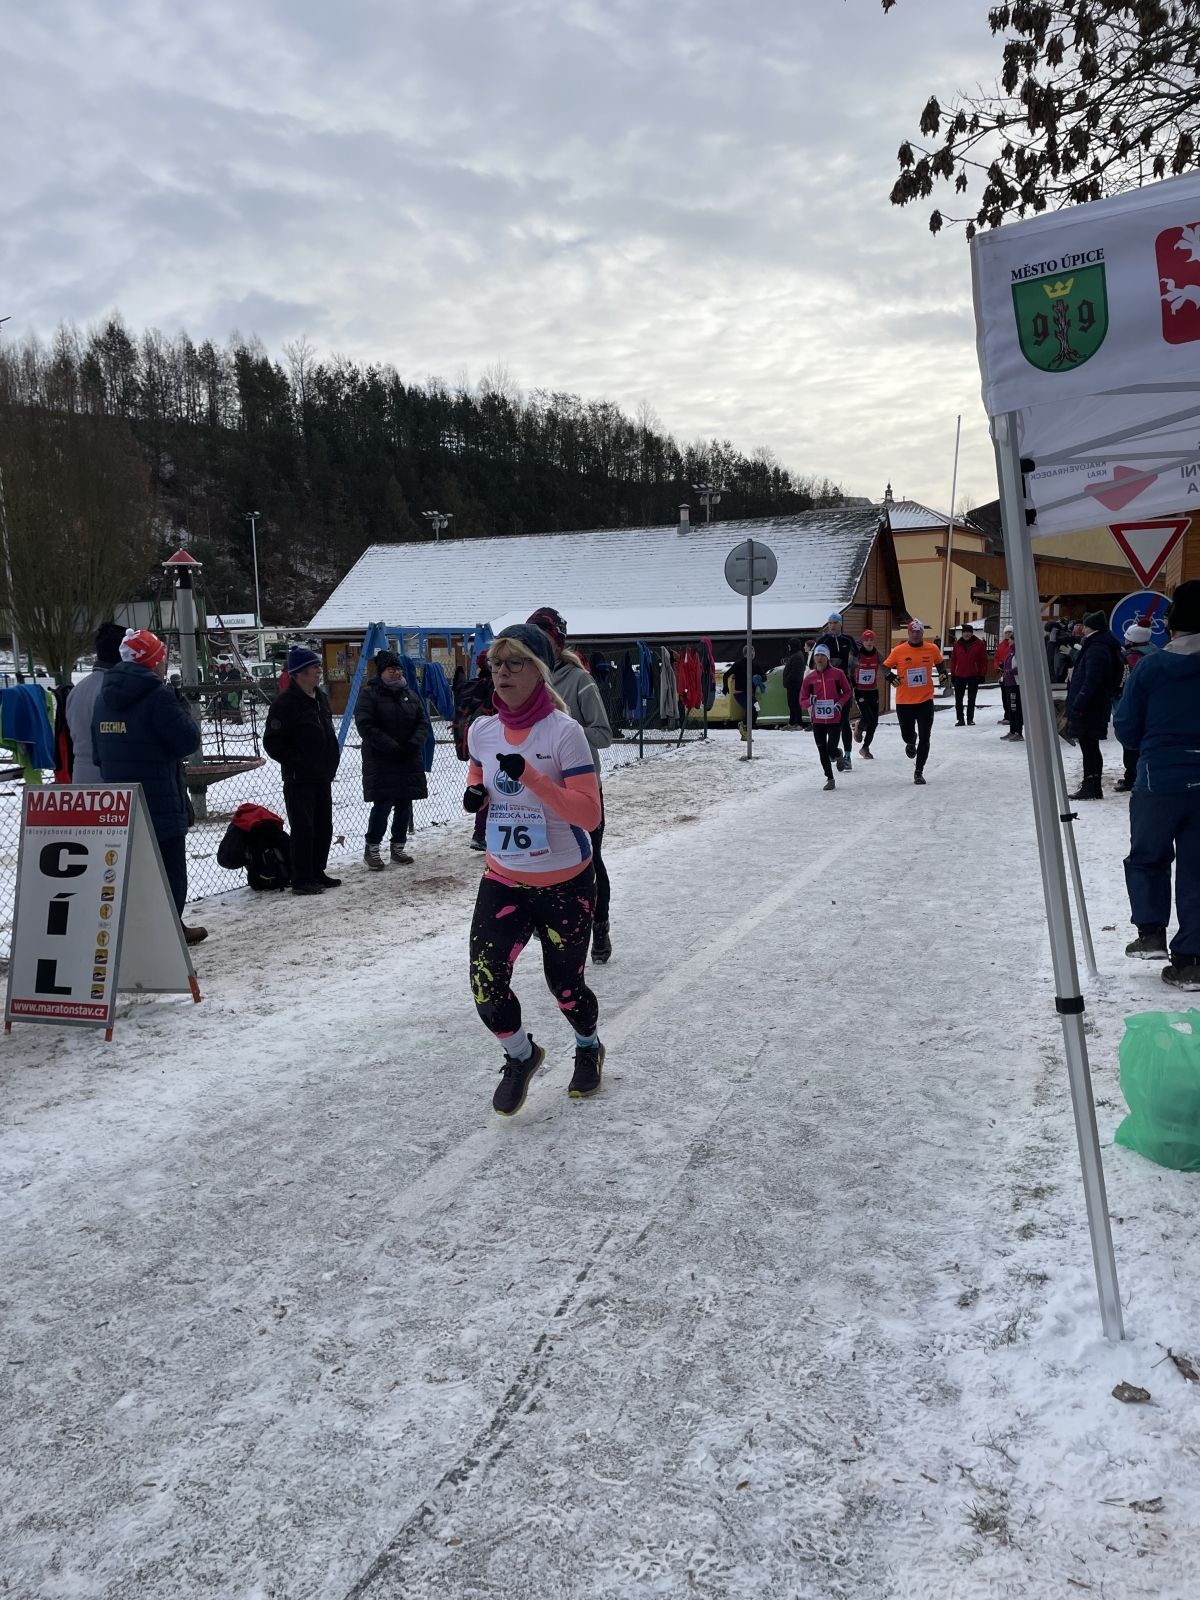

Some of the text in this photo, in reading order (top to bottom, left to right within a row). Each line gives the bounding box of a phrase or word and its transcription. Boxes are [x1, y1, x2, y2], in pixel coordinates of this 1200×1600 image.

[1011, 248, 1105, 281] MĚSTO ÚPICE
[913, 674, 923, 683] 41
[817, 707, 832, 715] 310
[100, 721, 127, 733] CZECHIA
[28, 791, 131, 811] MARATON
[98, 813, 125, 823] stav
[523, 812, 543, 820] LIGA
[75, 828, 103, 836] jednota
[106, 827, 127, 836] Úpice
[498, 825, 532, 850] 76
[35, 842, 89, 995] CÍL
[14, 1001, 104, 1017] www.maratonstav.cz
